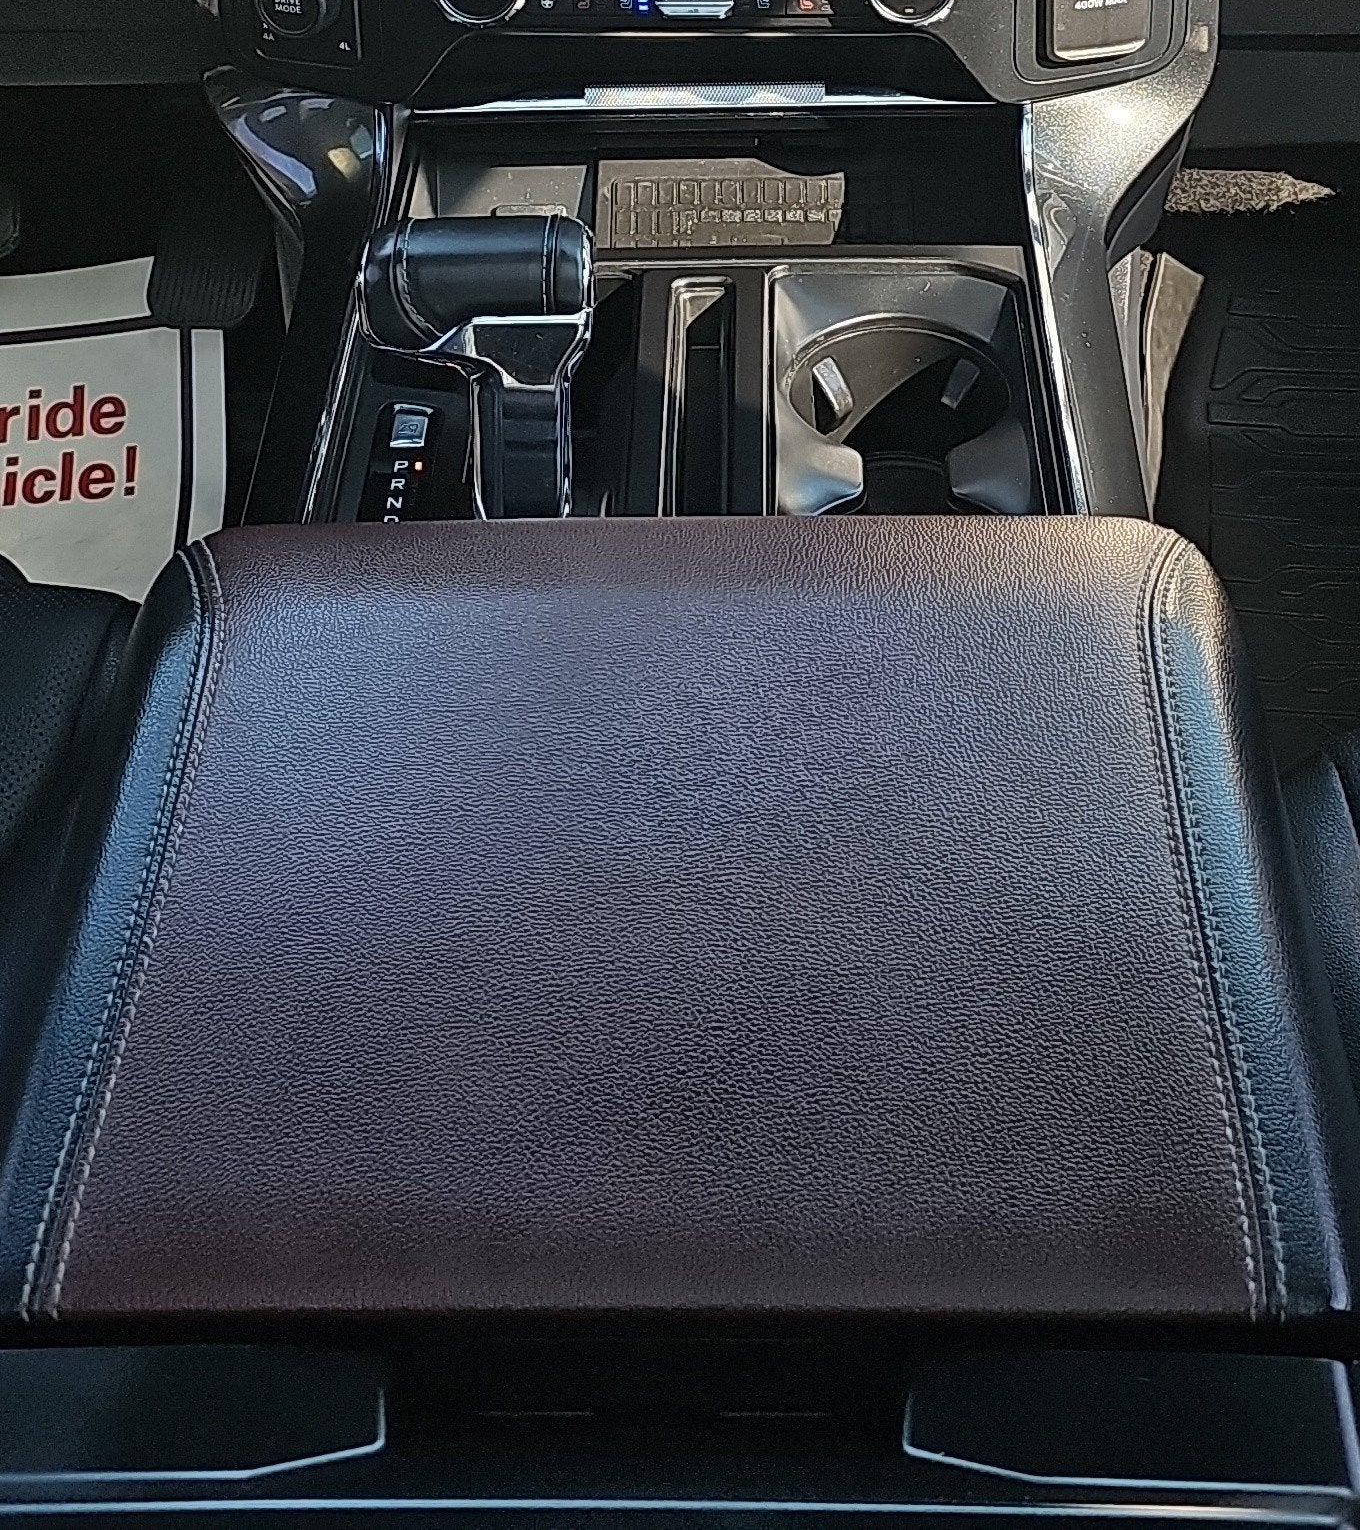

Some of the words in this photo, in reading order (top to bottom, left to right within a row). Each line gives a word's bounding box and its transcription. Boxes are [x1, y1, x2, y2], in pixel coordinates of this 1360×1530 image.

[274, 3, 302, 14] MODE
[339, 41, 351, 51] 4L
[393, 461, 409, 472] P
[390, 478, 405, 490] R
[386, 496, 402, 509] N
